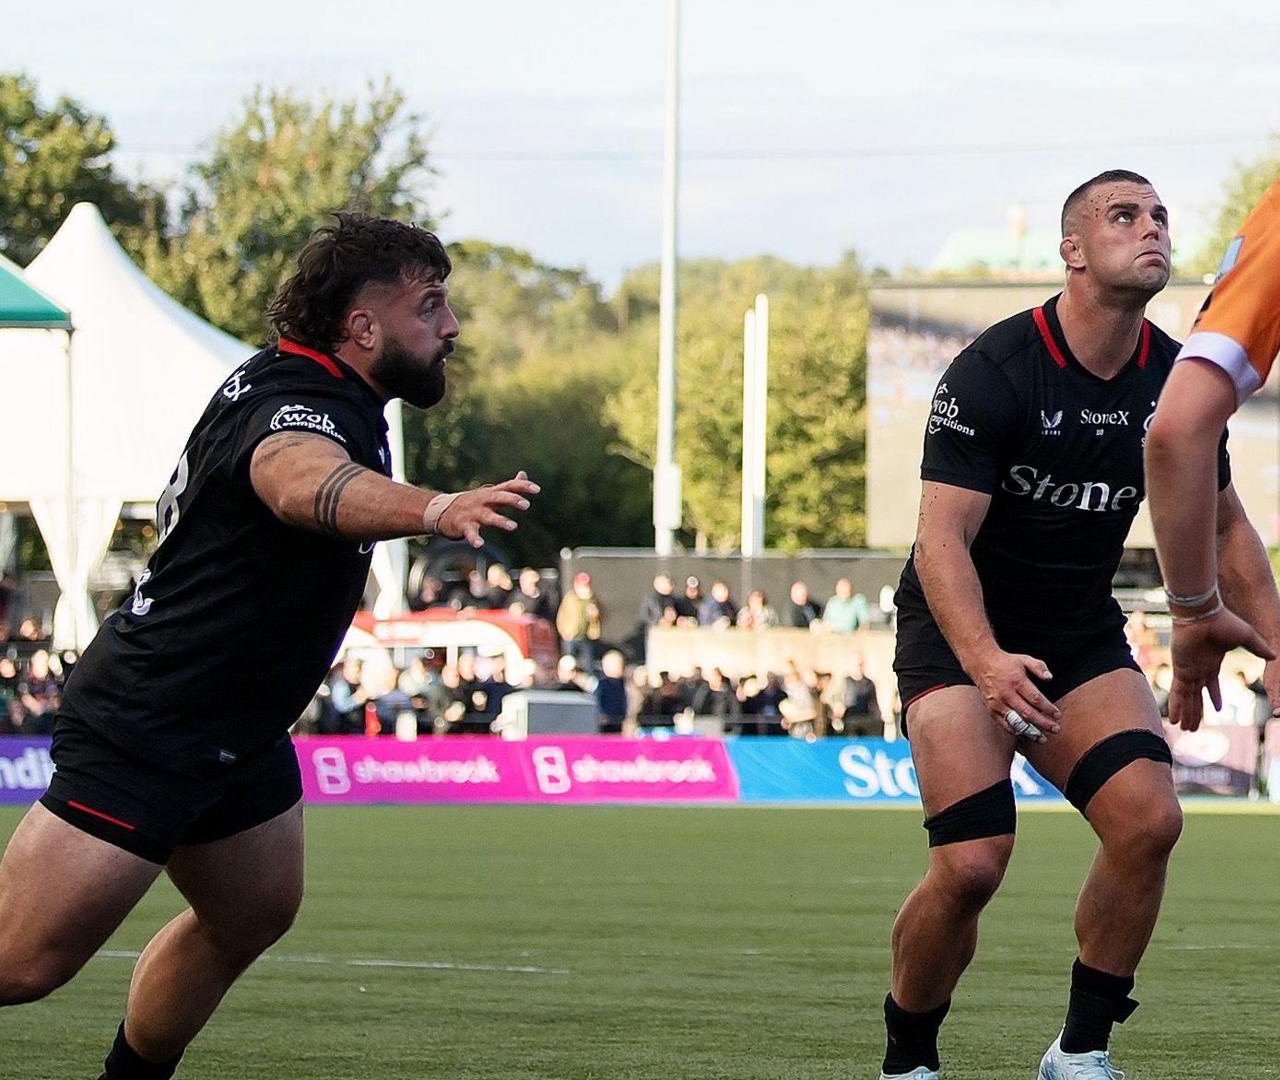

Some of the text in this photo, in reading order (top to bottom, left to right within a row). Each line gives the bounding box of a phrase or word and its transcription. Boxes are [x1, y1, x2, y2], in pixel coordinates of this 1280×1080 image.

[282, 412, 336, 431] wob
[1080, 408, 1130, 426] StoneX
[1001, 465, 1139, 512] Stone
[352, 755, 499, 784] shawbrook
[572, 755, 717, 784] shawbrook
